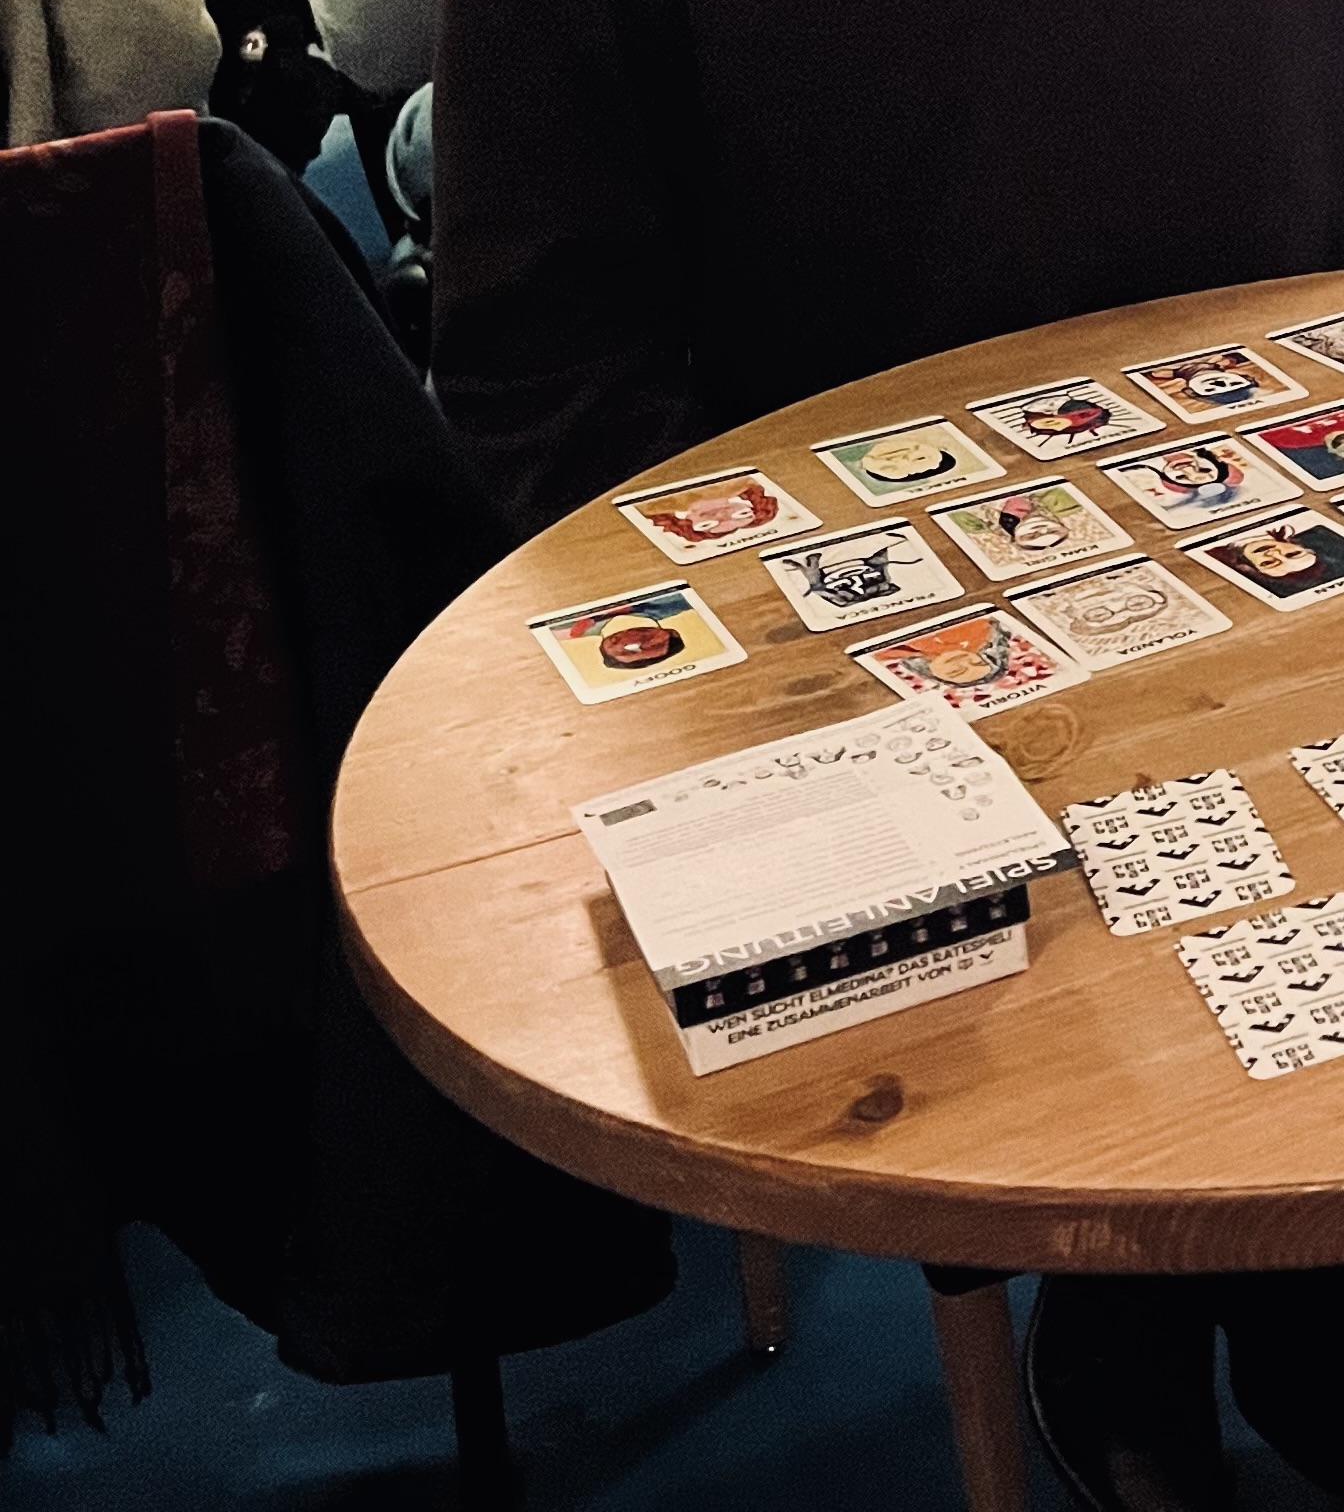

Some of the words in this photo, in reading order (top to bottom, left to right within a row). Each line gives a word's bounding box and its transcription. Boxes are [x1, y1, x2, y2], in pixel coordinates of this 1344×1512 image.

[905, 476, 968, 496] MARCEL
[1209, 496, 1262, 515] DENISE
[835, 591, 936, 622] FRANCESCA
[1117, 628, 1199, 657] YOLANDA
[633, 663, 697, 688] GOOFY
[979, 682, 1048, 709] VITORIA
[677, 854, 1060, 978] SPIELANLEITUNG
[708, 1013, 748, 1034] WEN
[751, 995, 804, 1021] SUCHT
[898, 956, 929, 975] DAS
[728, 1024, 762, 1045] EINE
[767, 976, 912, 1032] ZUSAMMENARBEIT
[918, 964, 953, 981] VON
